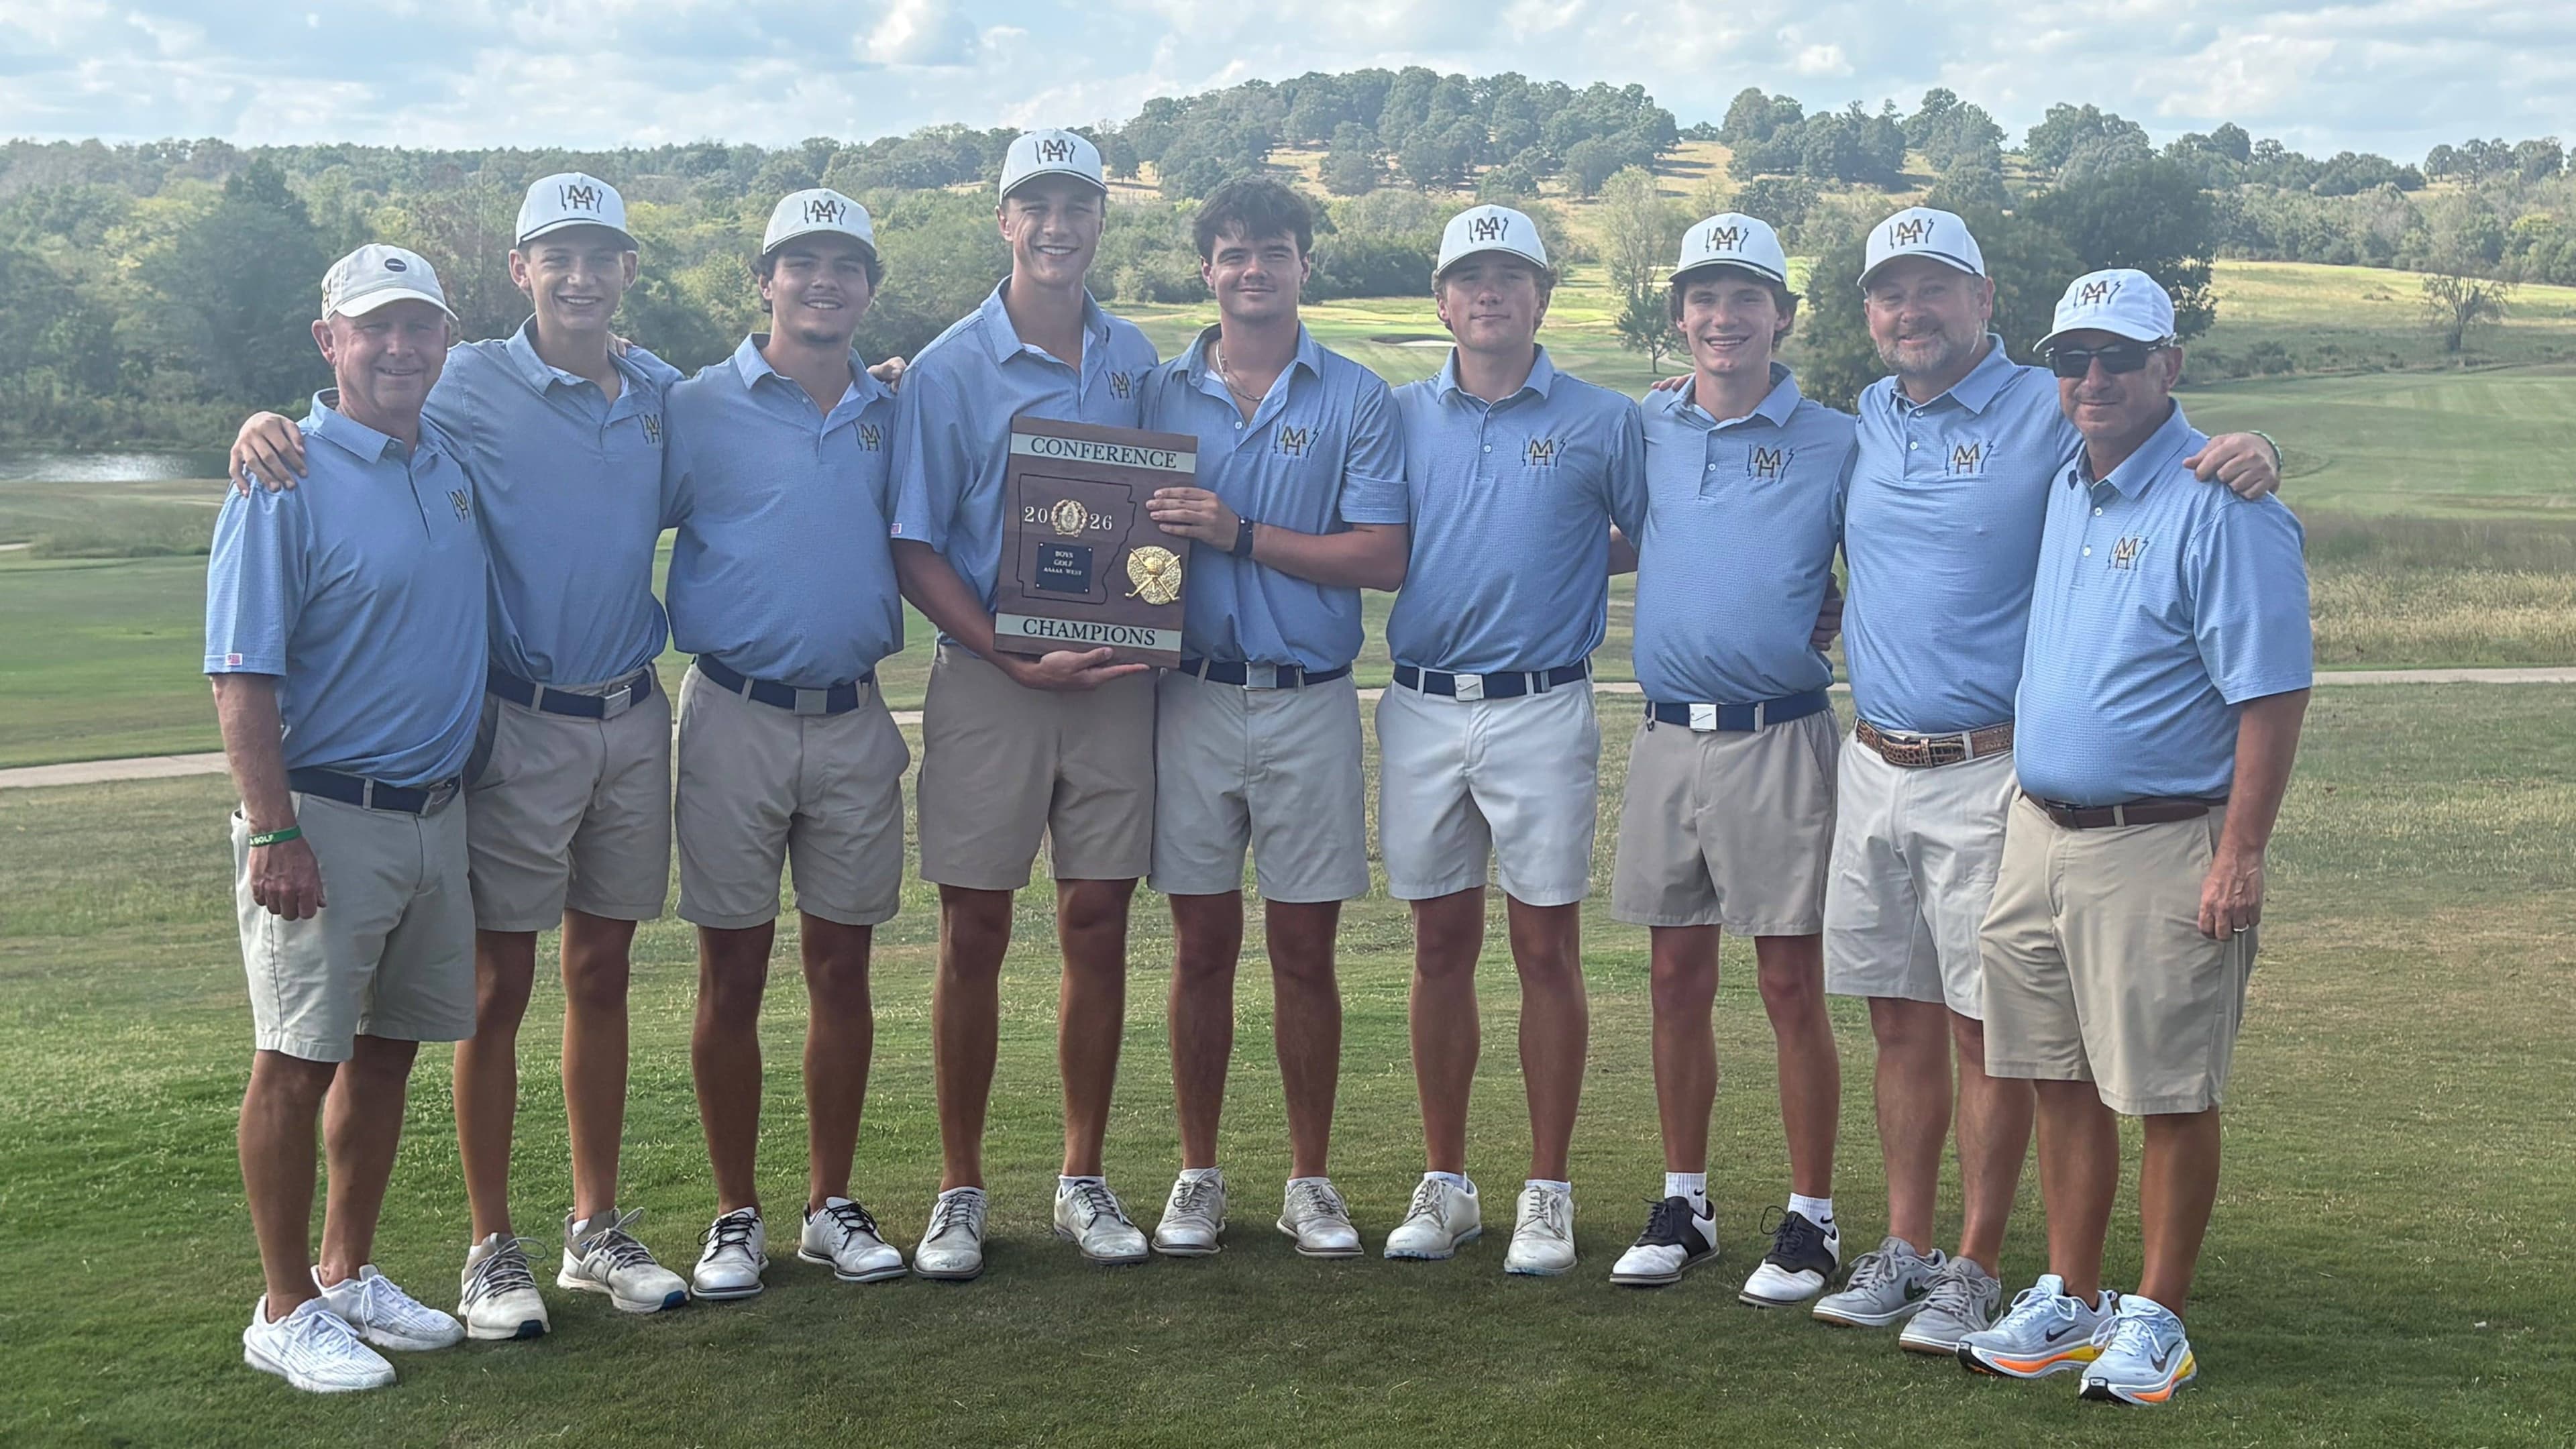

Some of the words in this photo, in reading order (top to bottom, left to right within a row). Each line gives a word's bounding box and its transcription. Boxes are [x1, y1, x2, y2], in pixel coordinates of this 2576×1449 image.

[1031, 437, 1177, 469] CONFERENCE
[1024, 506, 1048, 523] 20
[1089, 513, 1112, 530] 26
[1053, 559, 1073, 568] GOLF
[1022, 619, 1163, 646] CHAMPIONS
